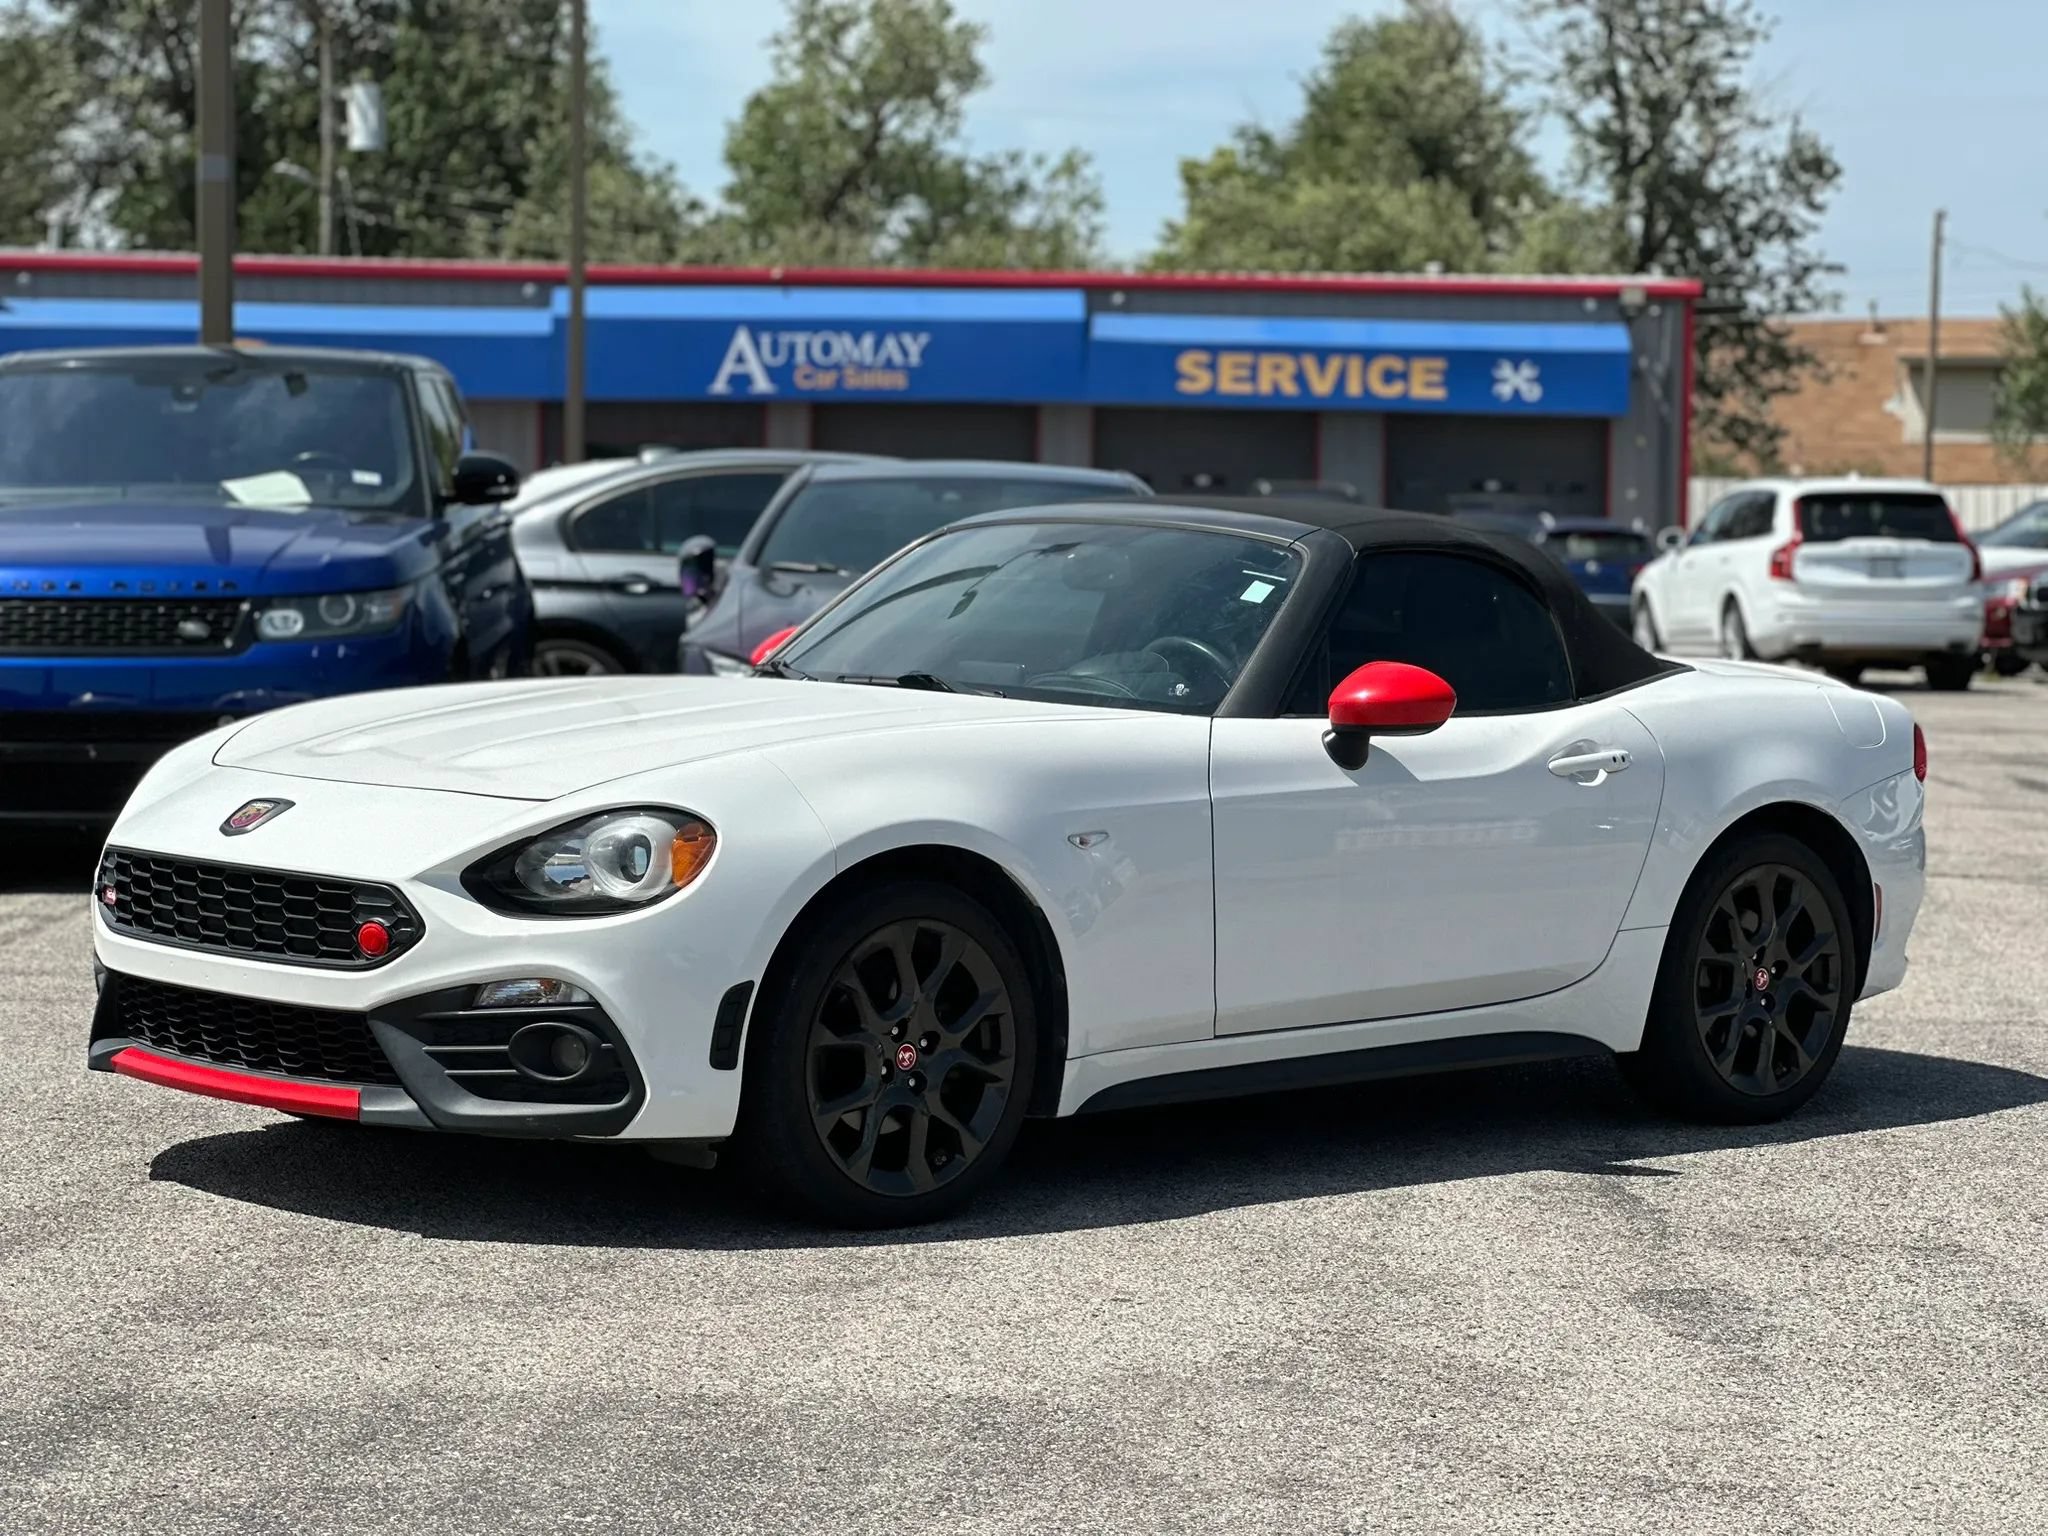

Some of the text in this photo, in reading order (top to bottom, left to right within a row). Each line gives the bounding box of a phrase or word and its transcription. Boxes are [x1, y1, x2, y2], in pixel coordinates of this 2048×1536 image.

[708, 324, 930, 395] AUTOMAY
[794, 365, 838, 390] Car
[1175, 350, 1448, 400] SERVICE
